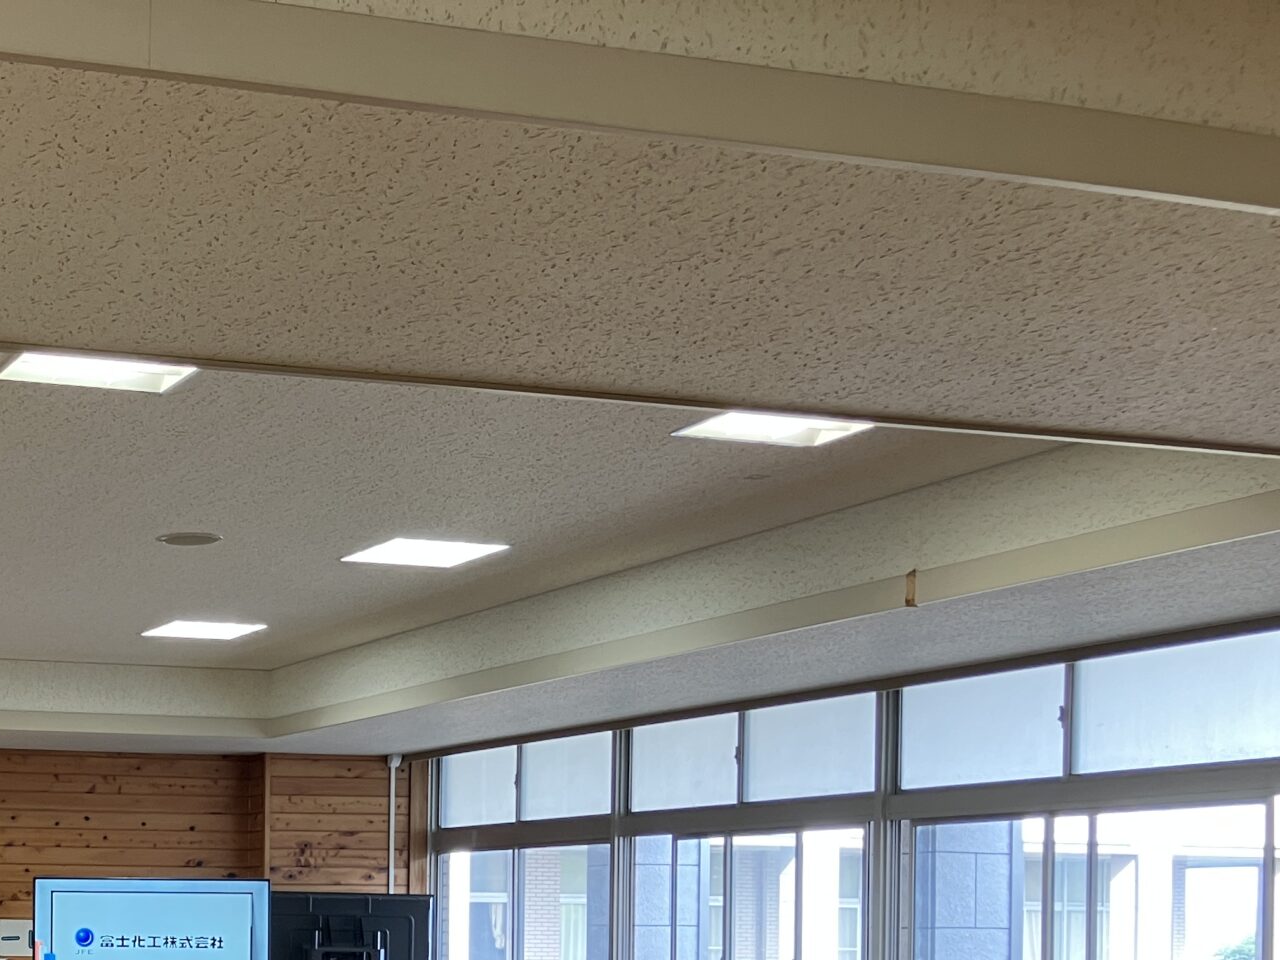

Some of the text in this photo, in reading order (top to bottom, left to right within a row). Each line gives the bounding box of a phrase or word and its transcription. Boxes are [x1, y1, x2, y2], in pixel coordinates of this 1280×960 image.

[100, 935, 224, 949] 富士化工株式会社
